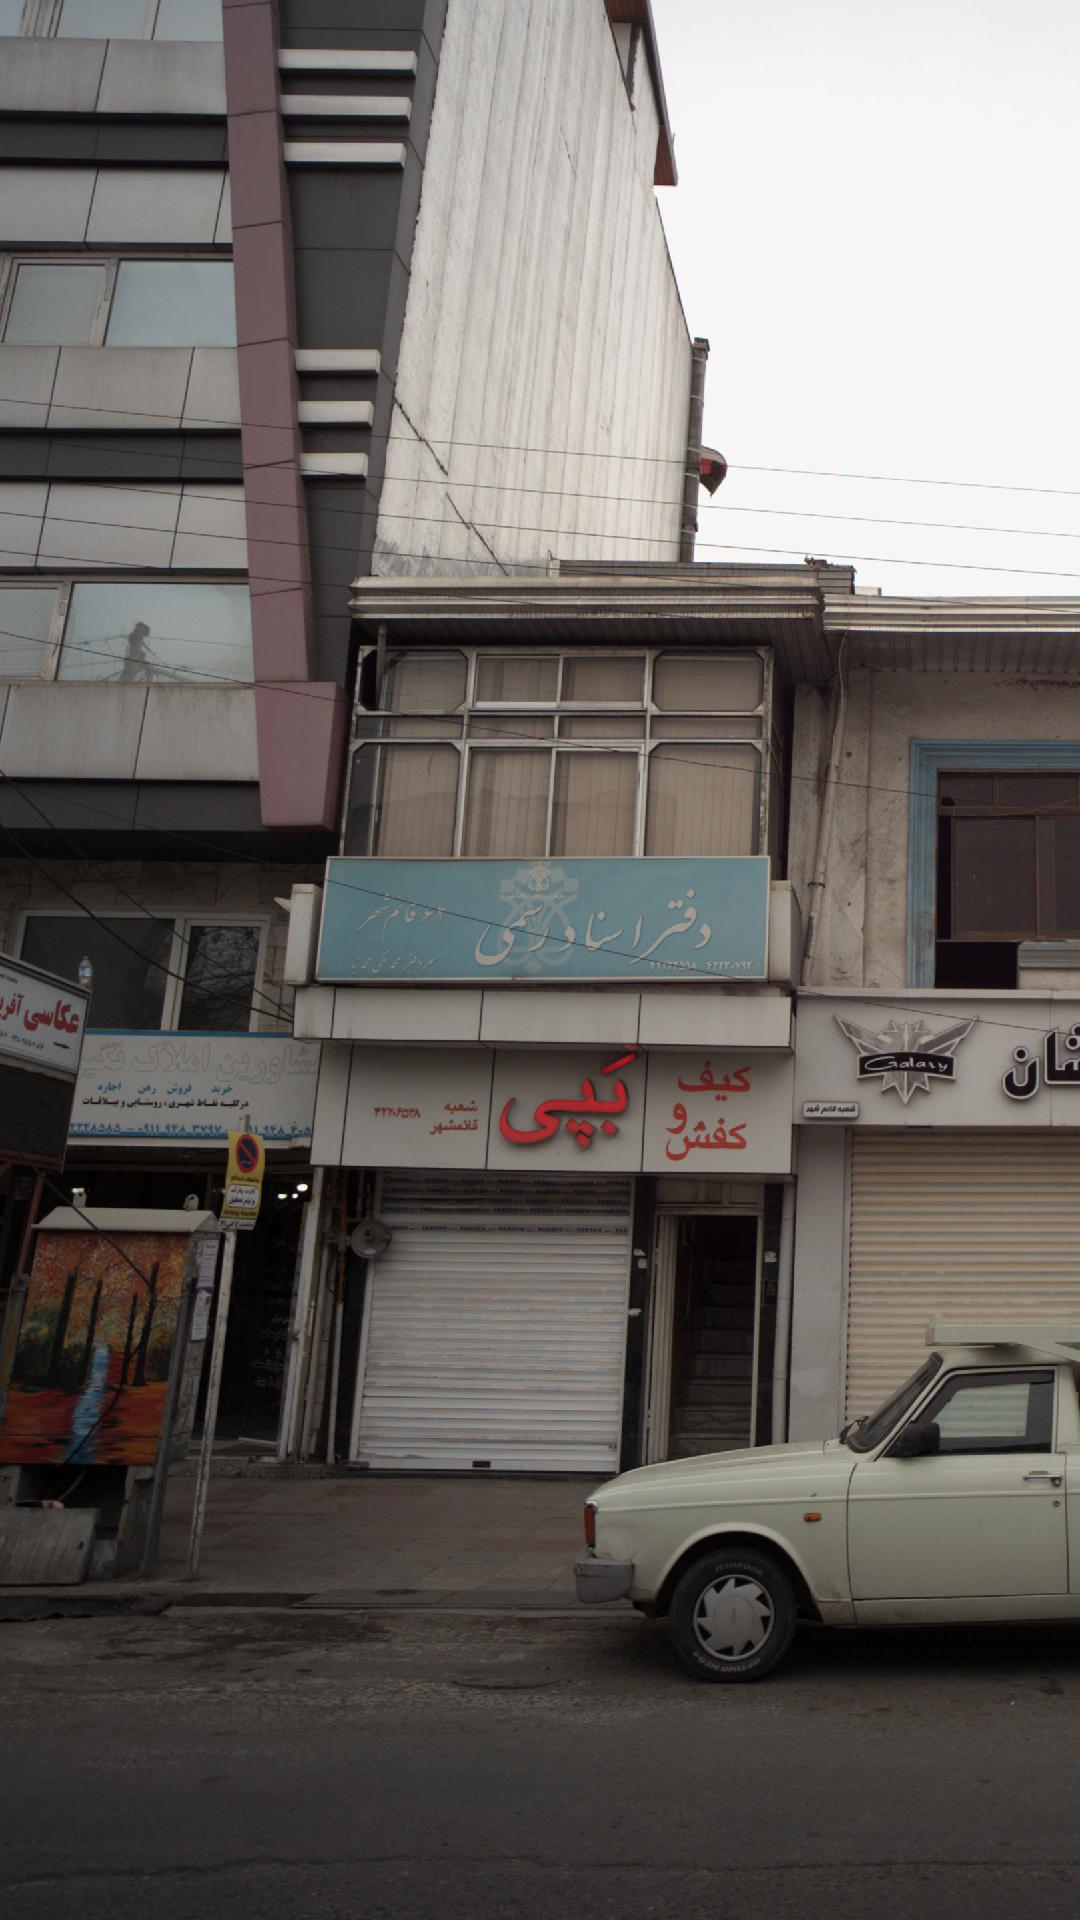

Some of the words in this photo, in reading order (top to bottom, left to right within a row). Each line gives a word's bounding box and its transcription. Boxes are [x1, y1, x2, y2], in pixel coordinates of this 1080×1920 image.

[474, 901, 550, 967] رسمی
[631, 888, 712, 965] دفتر
[23, 1000, 80, 1034] عکاسی
[130, 1040, 212, 1074] املاک
[216, 1042, 320, 1085] شاورین
[96, 1081, 122, 1093] اجاره
[137, 1083, 157, 1095] رهن
[166, 1081, 192, 1095] فروش
[211, 1084, 233, 1096] خرید
[677, 1061, 752, 1102] کیف
[120, 1100, 126, 1108] و
[443, 1099, 478, 1115] شعبه
[668, 1101, 689, 1135] و
[429, 1120, 479, 1136] قائمشهر
[664, 1120, 748, 1161] کفش
